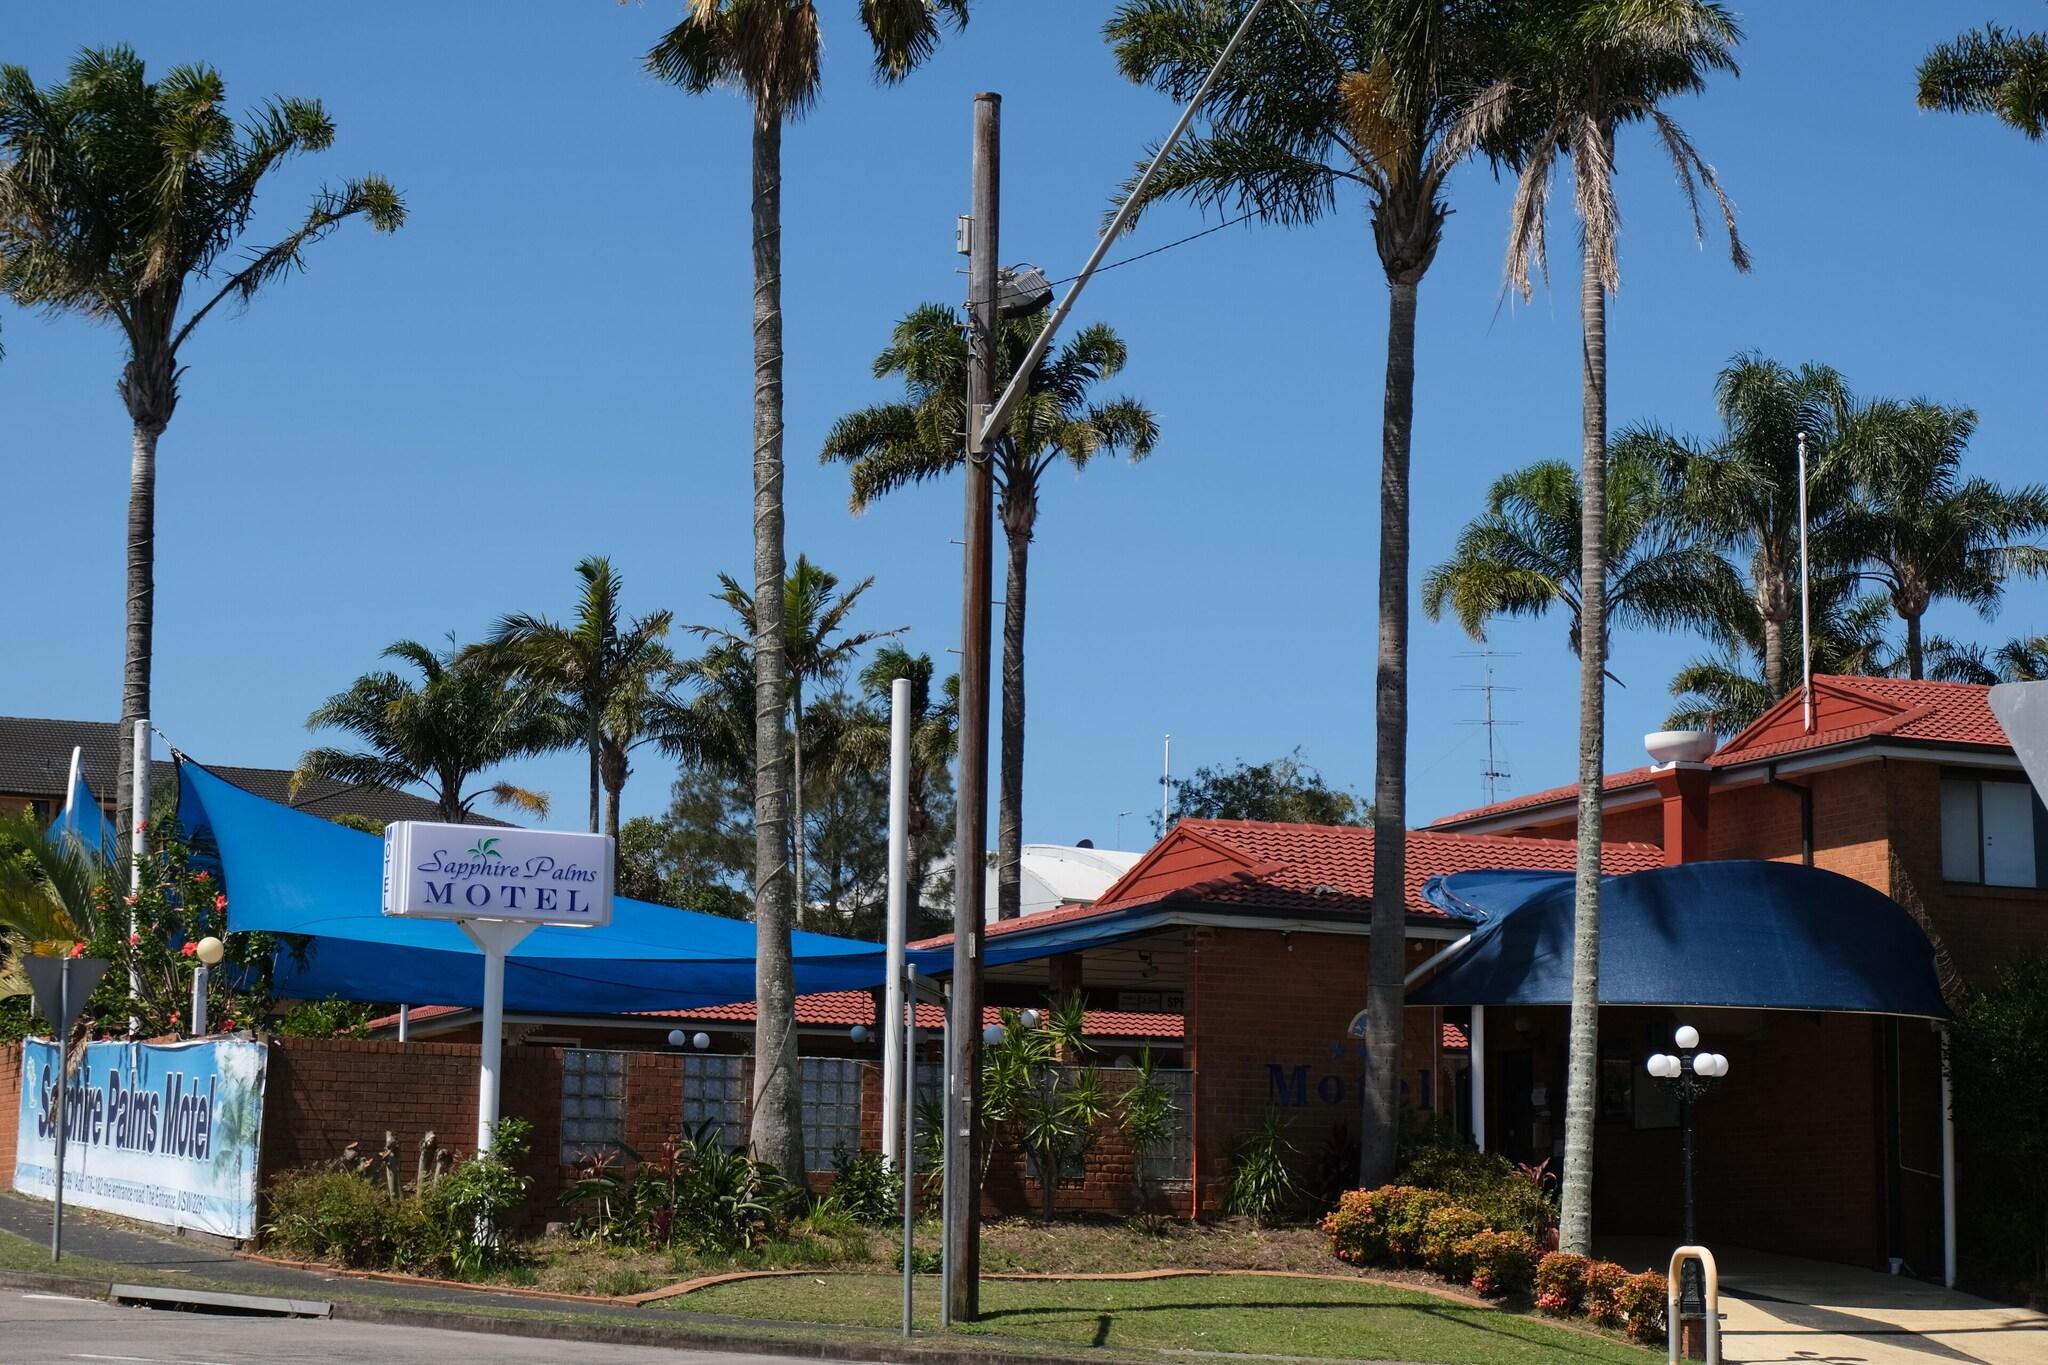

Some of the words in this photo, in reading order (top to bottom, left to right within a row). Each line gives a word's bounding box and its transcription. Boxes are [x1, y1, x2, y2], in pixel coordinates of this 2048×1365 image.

[382, 827, 393, 912] MOTEL
[417, 849, 520, 880] Sapphire
[522, 856, 598, 882] Palms
[423, 881, 590, 913] MOTEL
[105, 1068, 159, 1154] Palms
[160, 1072, 217, 1161] Motel
